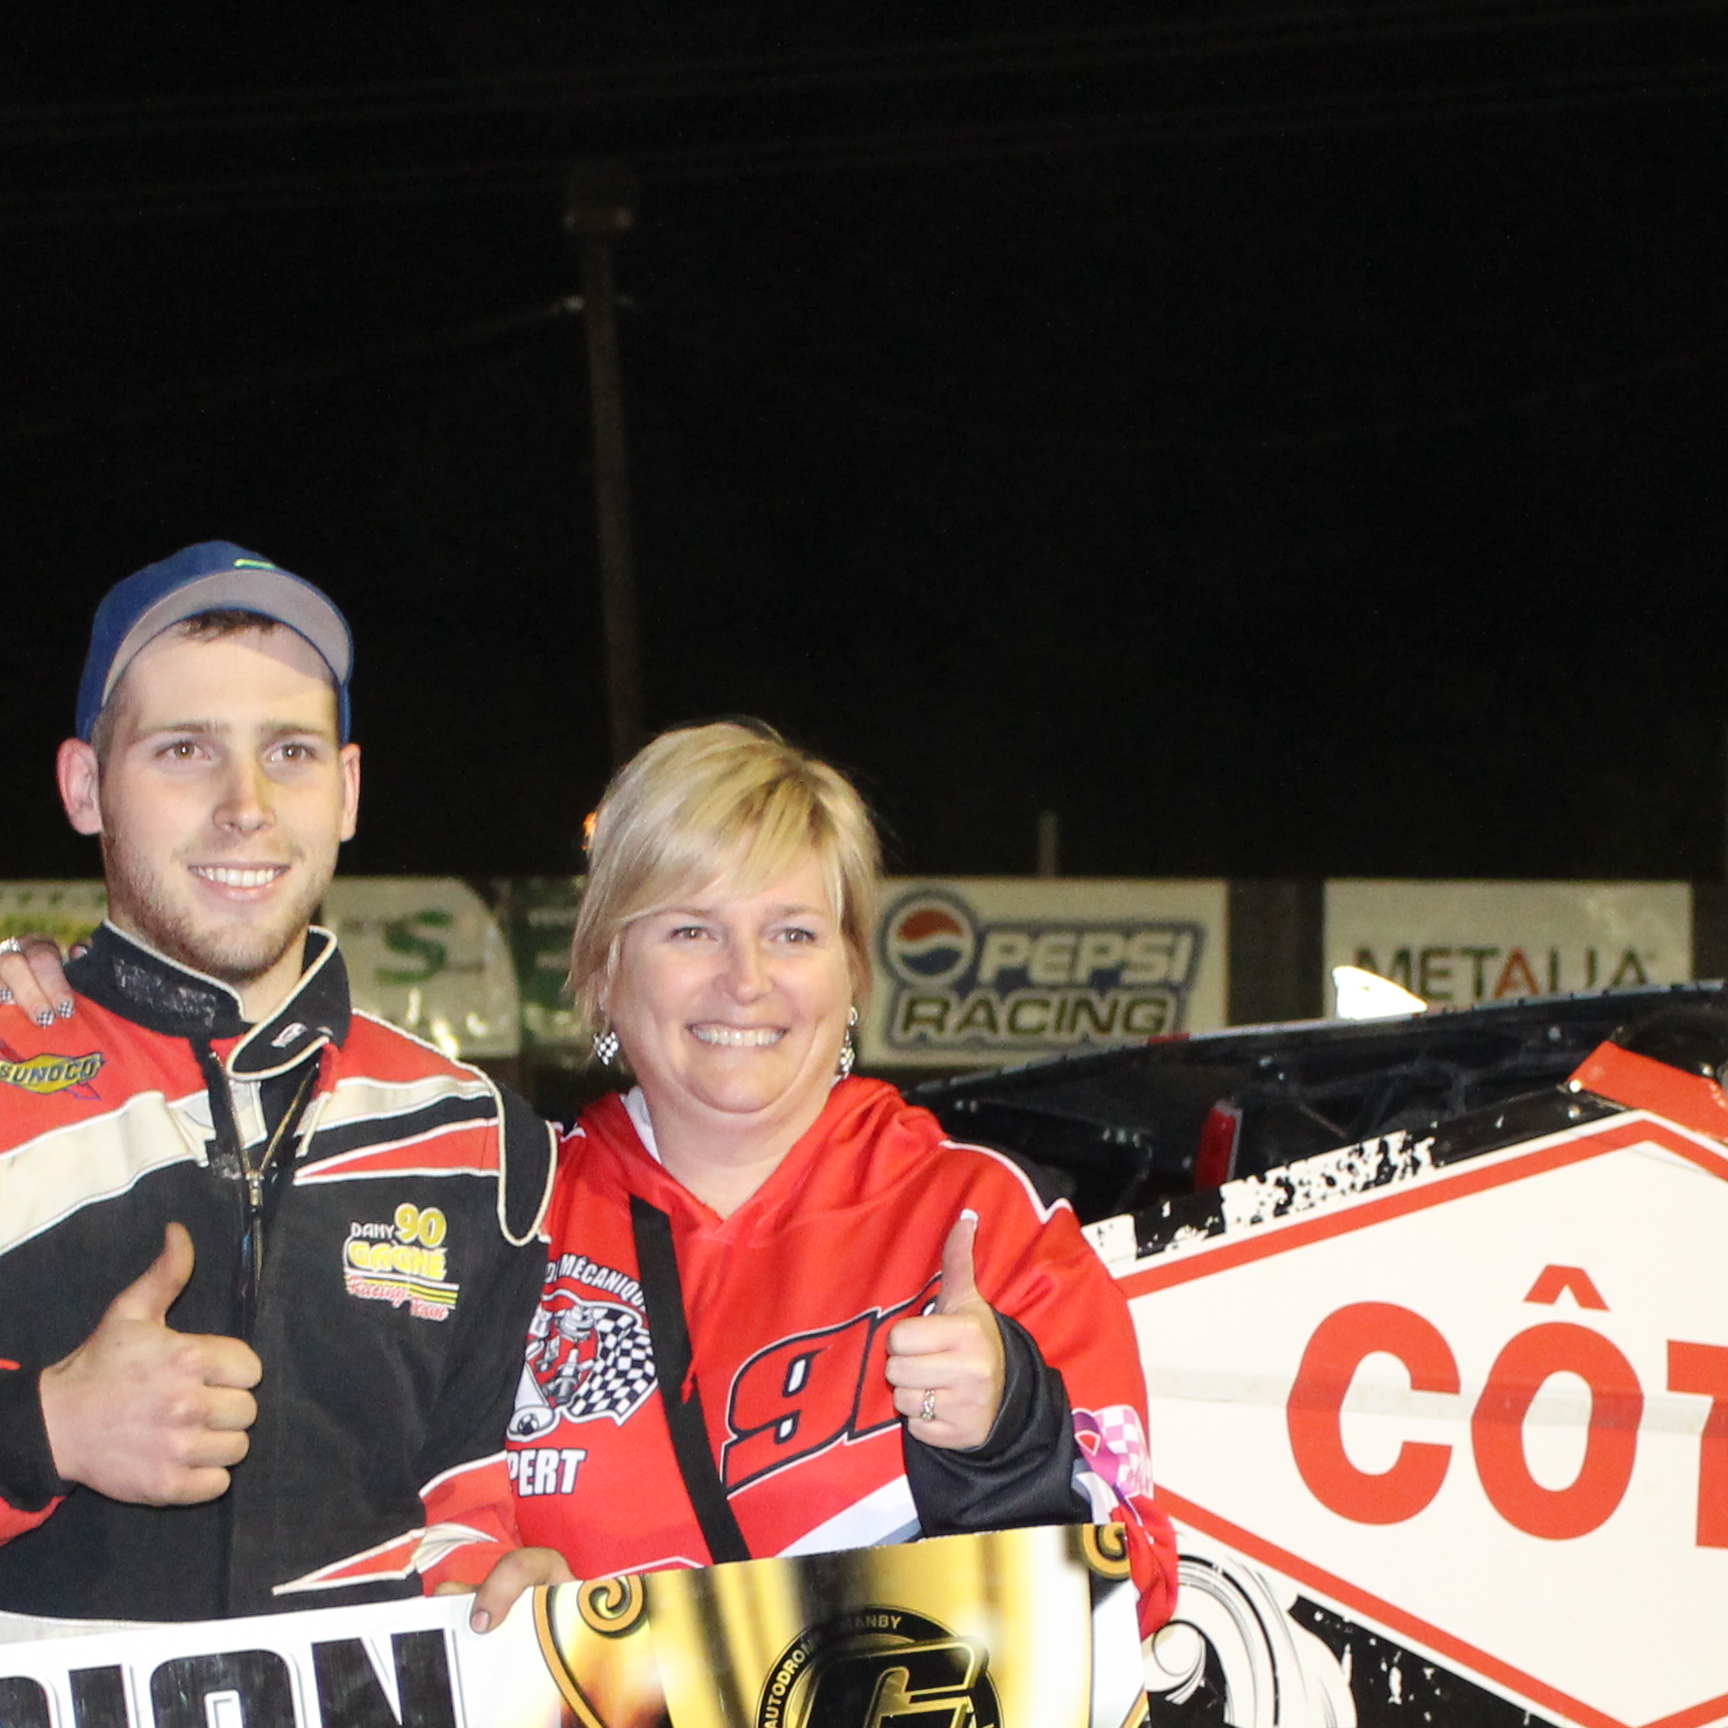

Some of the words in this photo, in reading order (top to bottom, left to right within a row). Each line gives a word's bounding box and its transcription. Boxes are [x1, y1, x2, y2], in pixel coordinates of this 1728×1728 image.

[978, 931, 1192, 984] PEPSI
[900, 996, 1180, 1040] RACING
[394, 1202, 448, 1249] 90
[558, 1253, 646, 1314] MÉCANIQU
